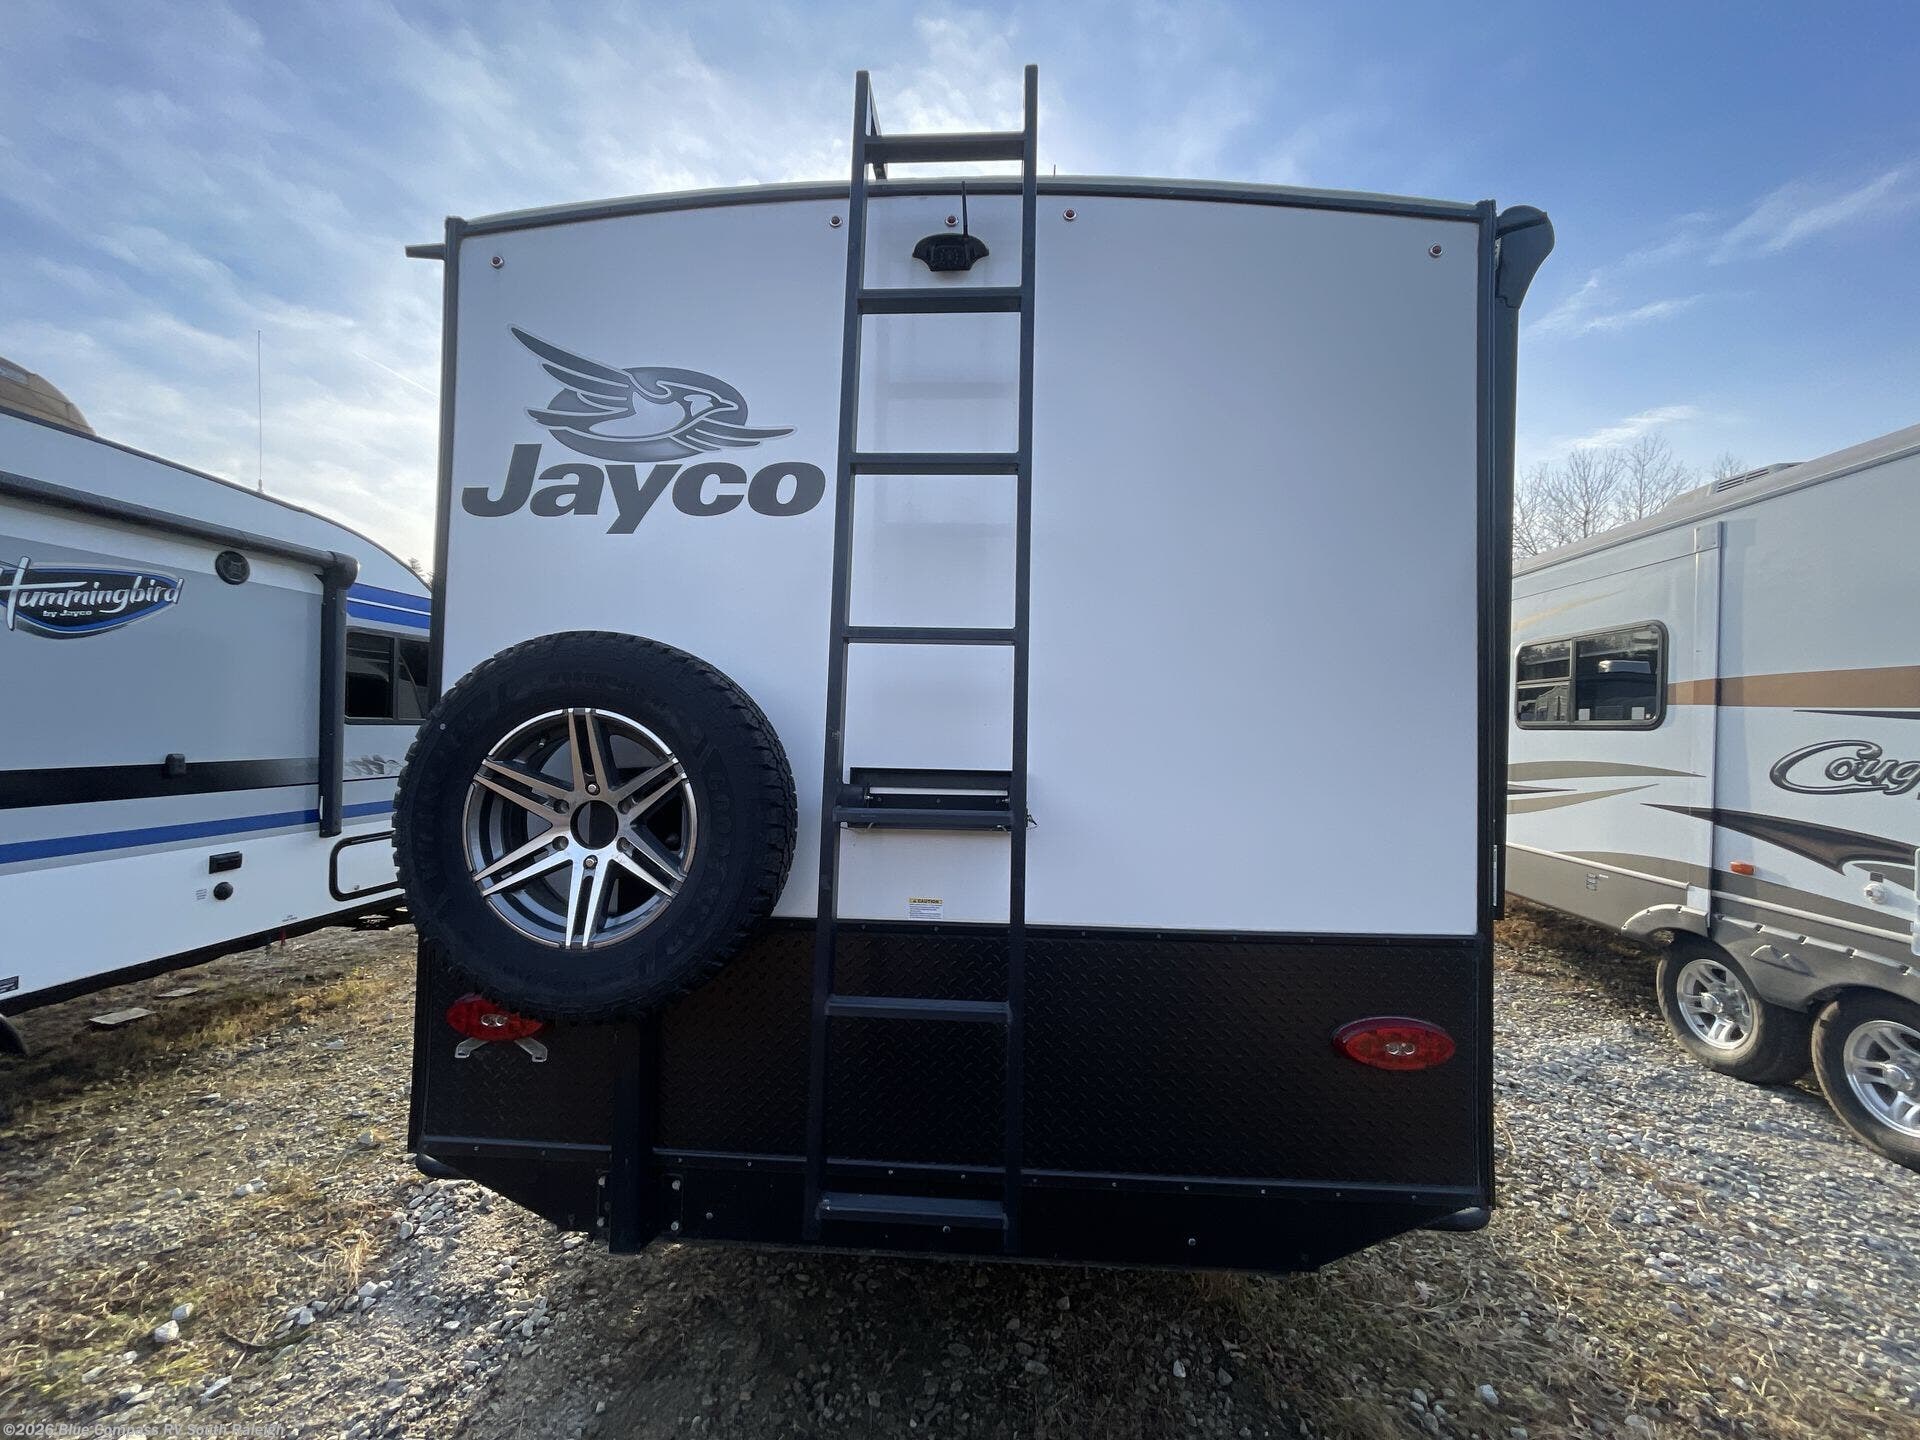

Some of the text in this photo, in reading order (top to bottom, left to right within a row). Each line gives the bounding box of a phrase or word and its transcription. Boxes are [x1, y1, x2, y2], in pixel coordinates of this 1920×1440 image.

[461, 443, 826, 535] Jayco
[0, 556, 184, 630] Hummingbird
[42, 609, 92, 618] by Jayco
